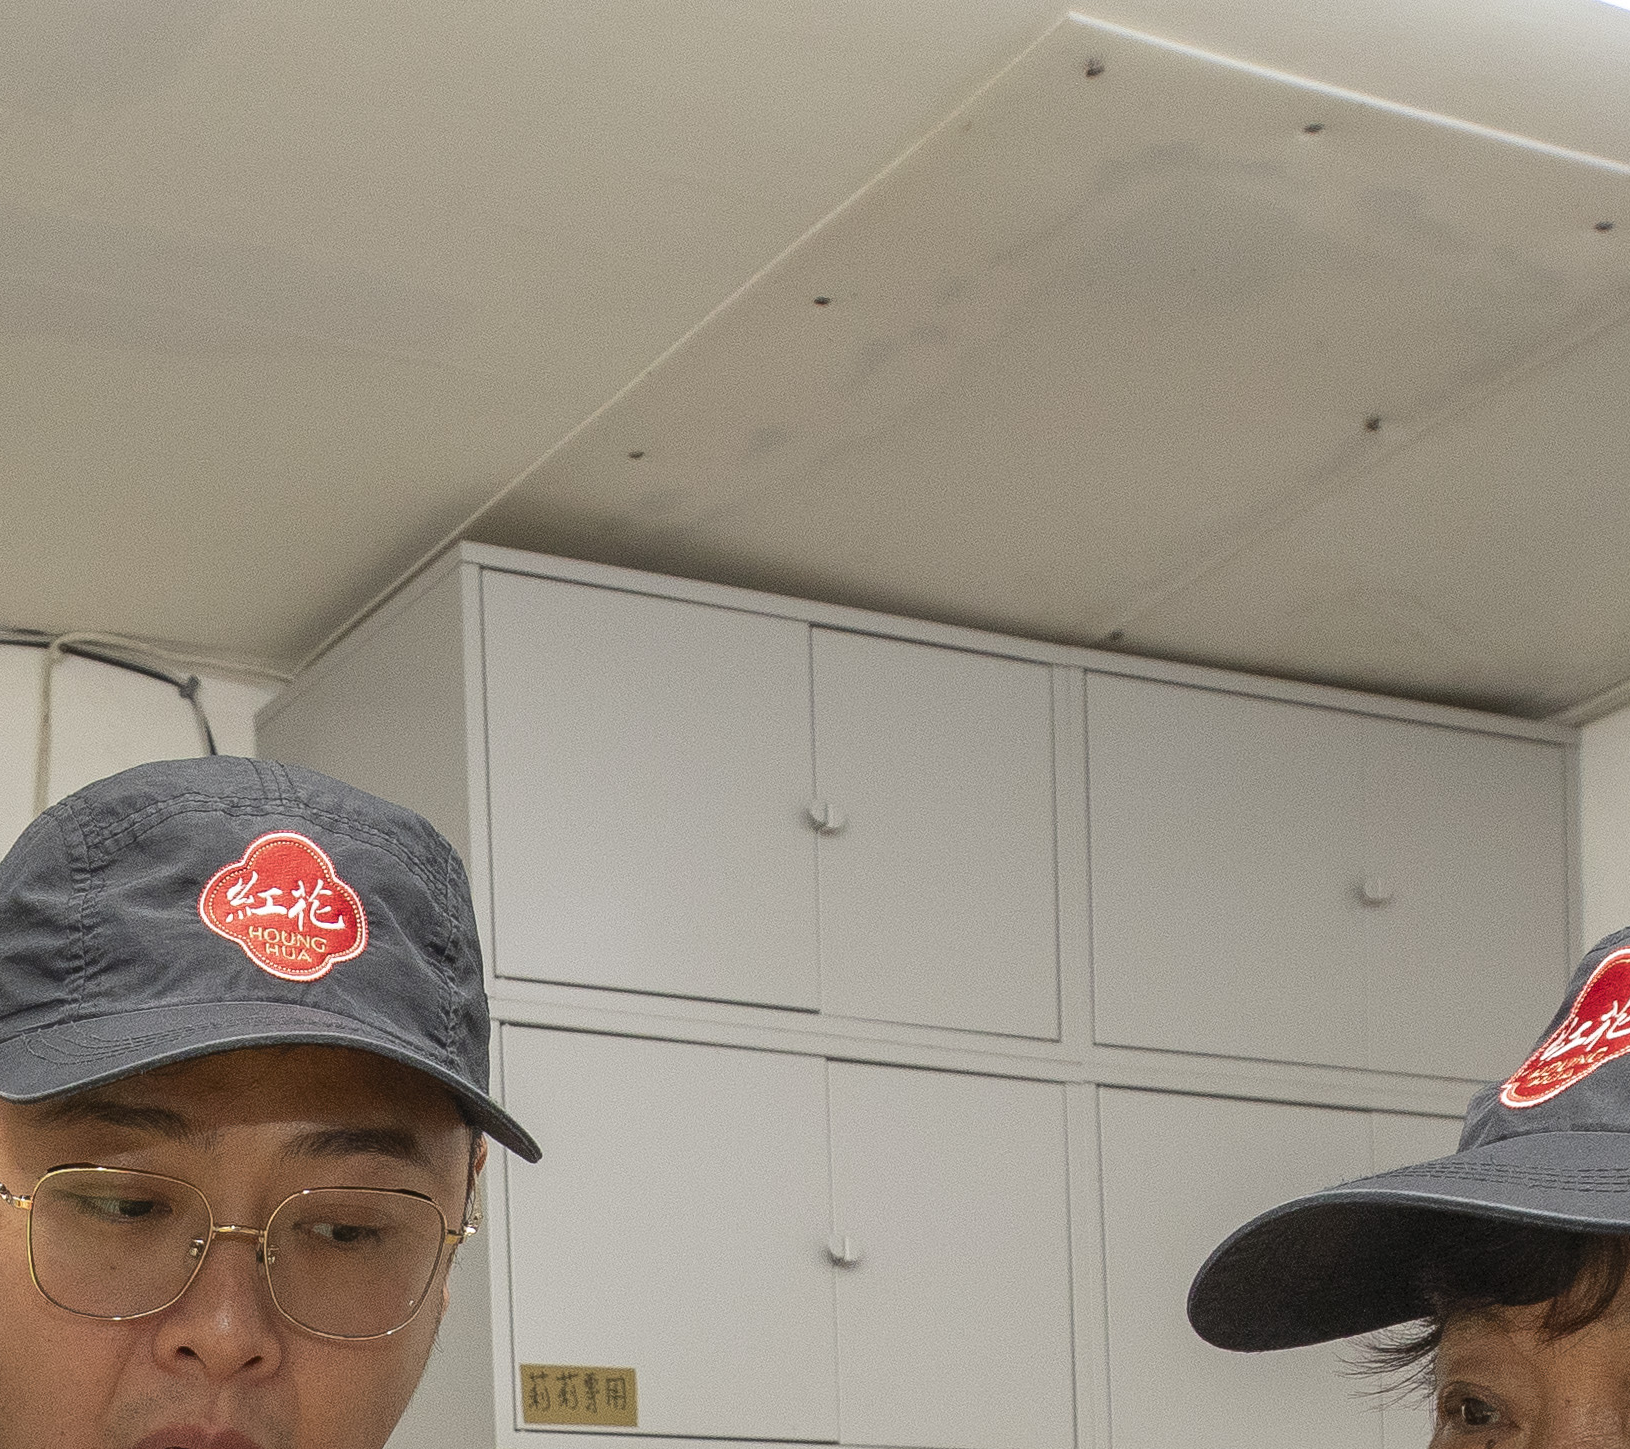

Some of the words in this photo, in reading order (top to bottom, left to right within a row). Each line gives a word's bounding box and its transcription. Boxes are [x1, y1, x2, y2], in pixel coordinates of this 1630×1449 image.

[226, 870, 345, 931] 紅花
[248, 925, 328, 953] HOUNG
[265, 942, 313, 963] HUA
